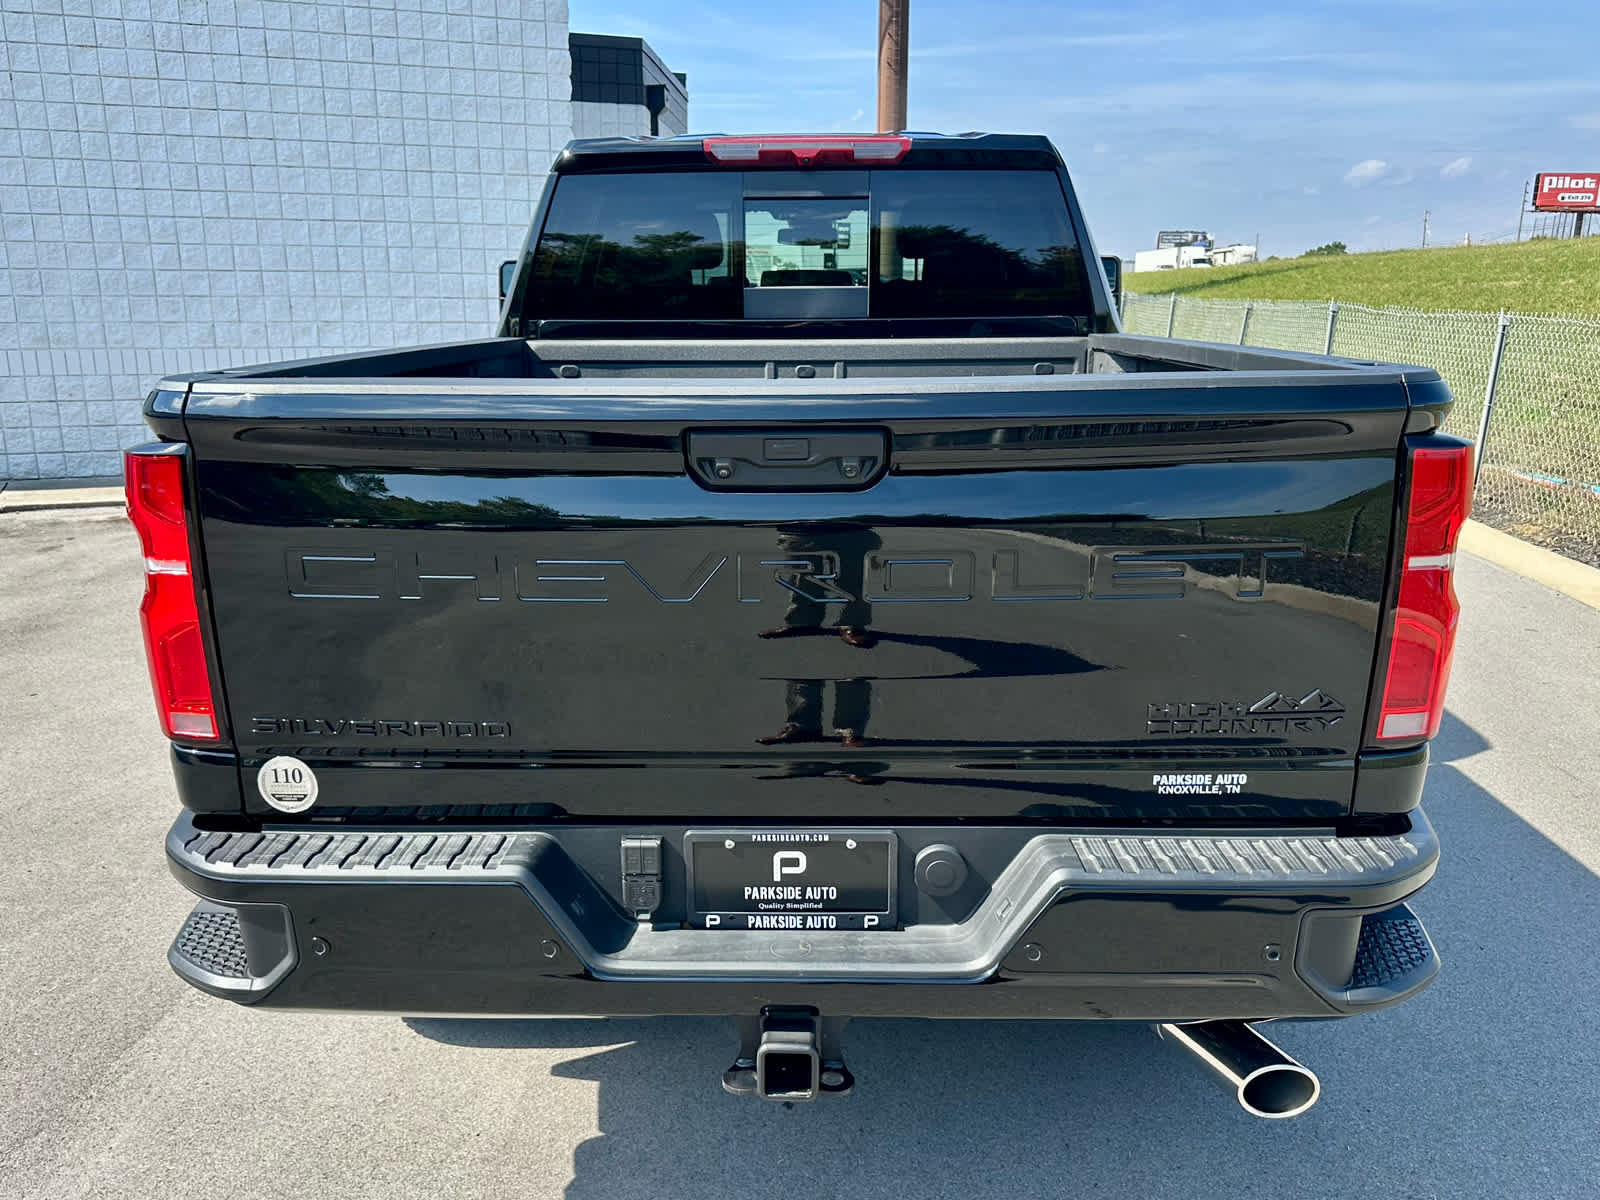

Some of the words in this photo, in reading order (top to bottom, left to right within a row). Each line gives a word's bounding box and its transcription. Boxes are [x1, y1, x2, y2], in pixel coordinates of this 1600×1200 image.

[286, 541, 1311, 603] CHEVROLET
[1146, 702, 1249, 719] HIGH
[251, 717, 512, 738] SILVERADO
[1146, 716, 1344, 735] COUNTRY
[271, 768, 303, 784] 110
[1152, 774, 1212, 785] PARKSIDE
[1215, 773, 1247, 785] AUTO
[1158, 785, 1222, 795] KNOXVILLE,
[1226, 784, 1241, 794] TN
[752, 834, 830, 842] PARKSIDEAUTO.COM
[773, 850, 807, 882] P
[744, 886, 802, 900] PARKSIDE
[805, 886, 837, 900] AUTO
[758, 902, 785, 910] Quality
[786, 902, 823, 910] Simplified
[705, 915, 721, 928] P
[747, 915, 803, 929] PARKSIDE
[806, 915, 837, 929] AUTO
[864, 915, 879, 929] P
